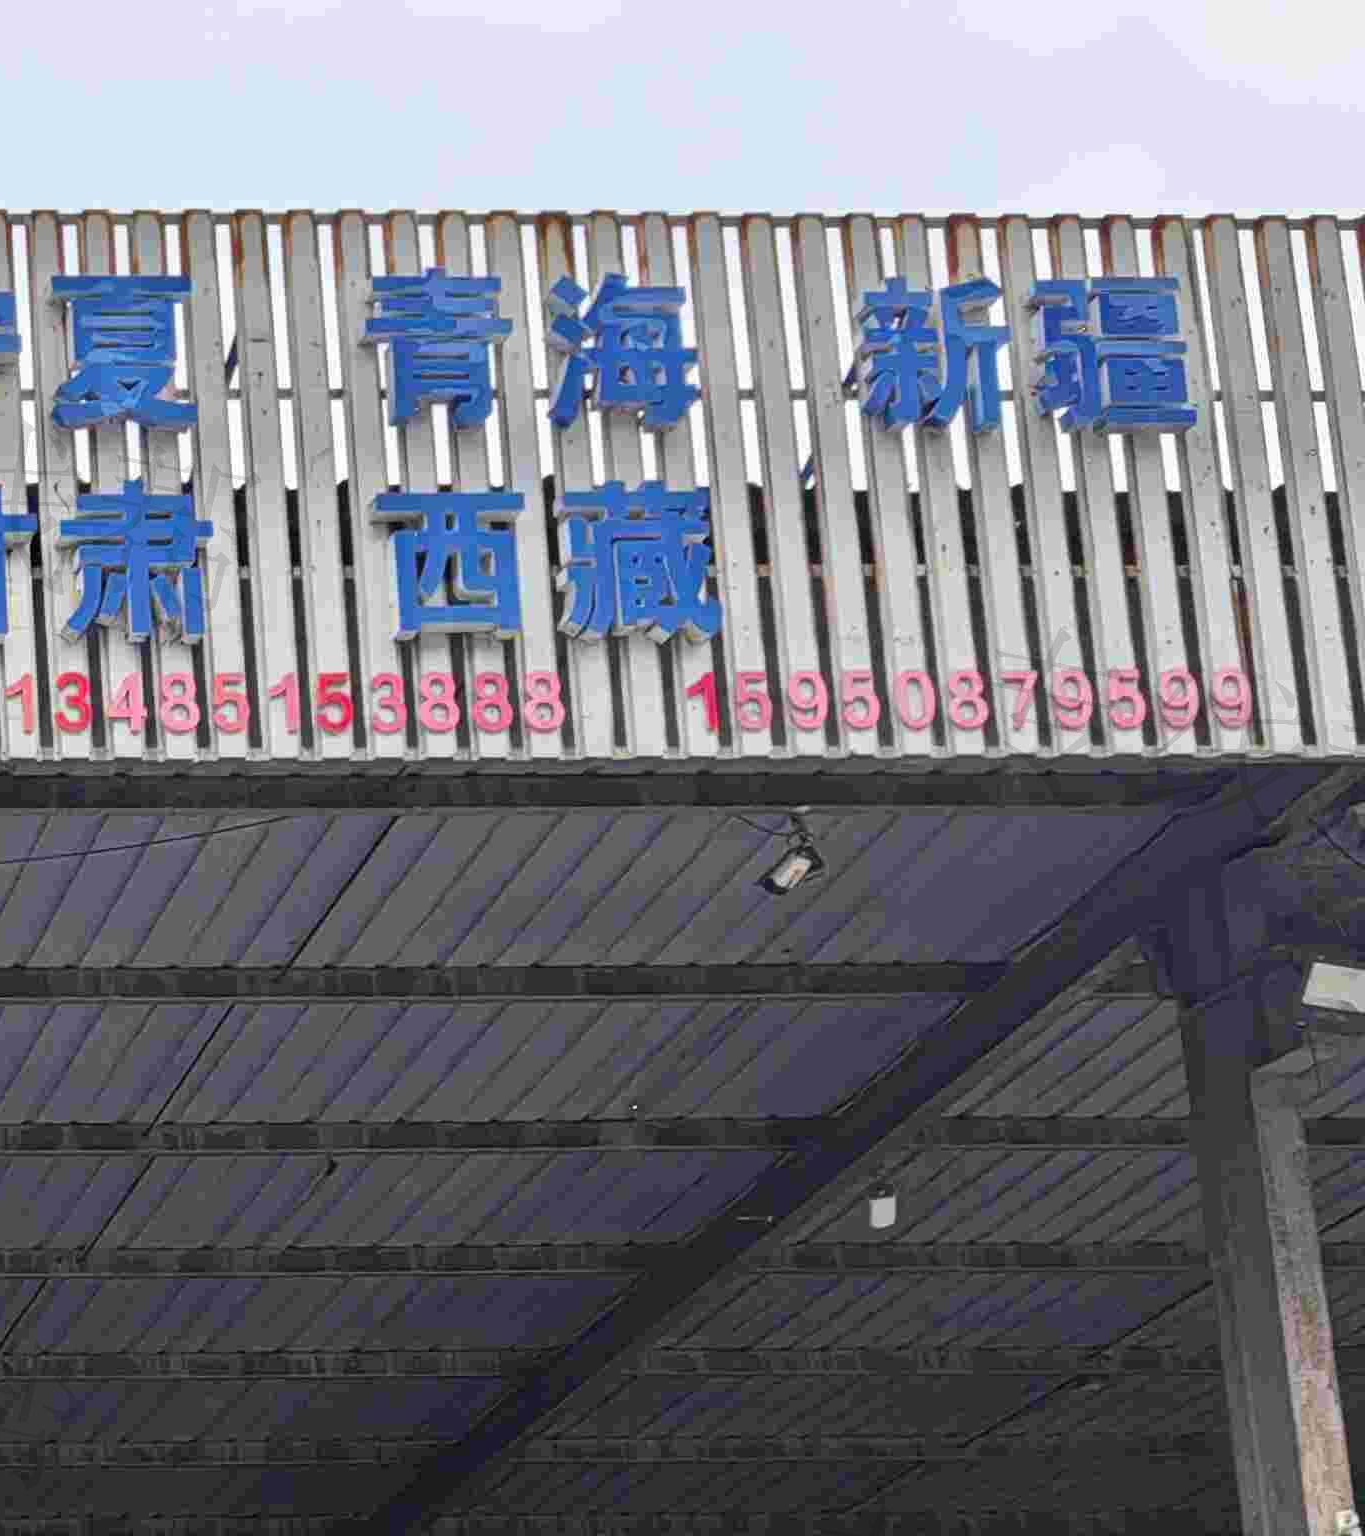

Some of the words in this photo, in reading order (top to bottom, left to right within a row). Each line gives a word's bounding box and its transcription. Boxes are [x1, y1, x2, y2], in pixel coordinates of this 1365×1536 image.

[364, 268, 699, 430] 青海
[856, 273, 1198, 434] 新疆
[369, 481, 722, 643] 西藏
[3, 671, 566, 736] 13485153888
[685, 664, 1255, 734] 15950879599
